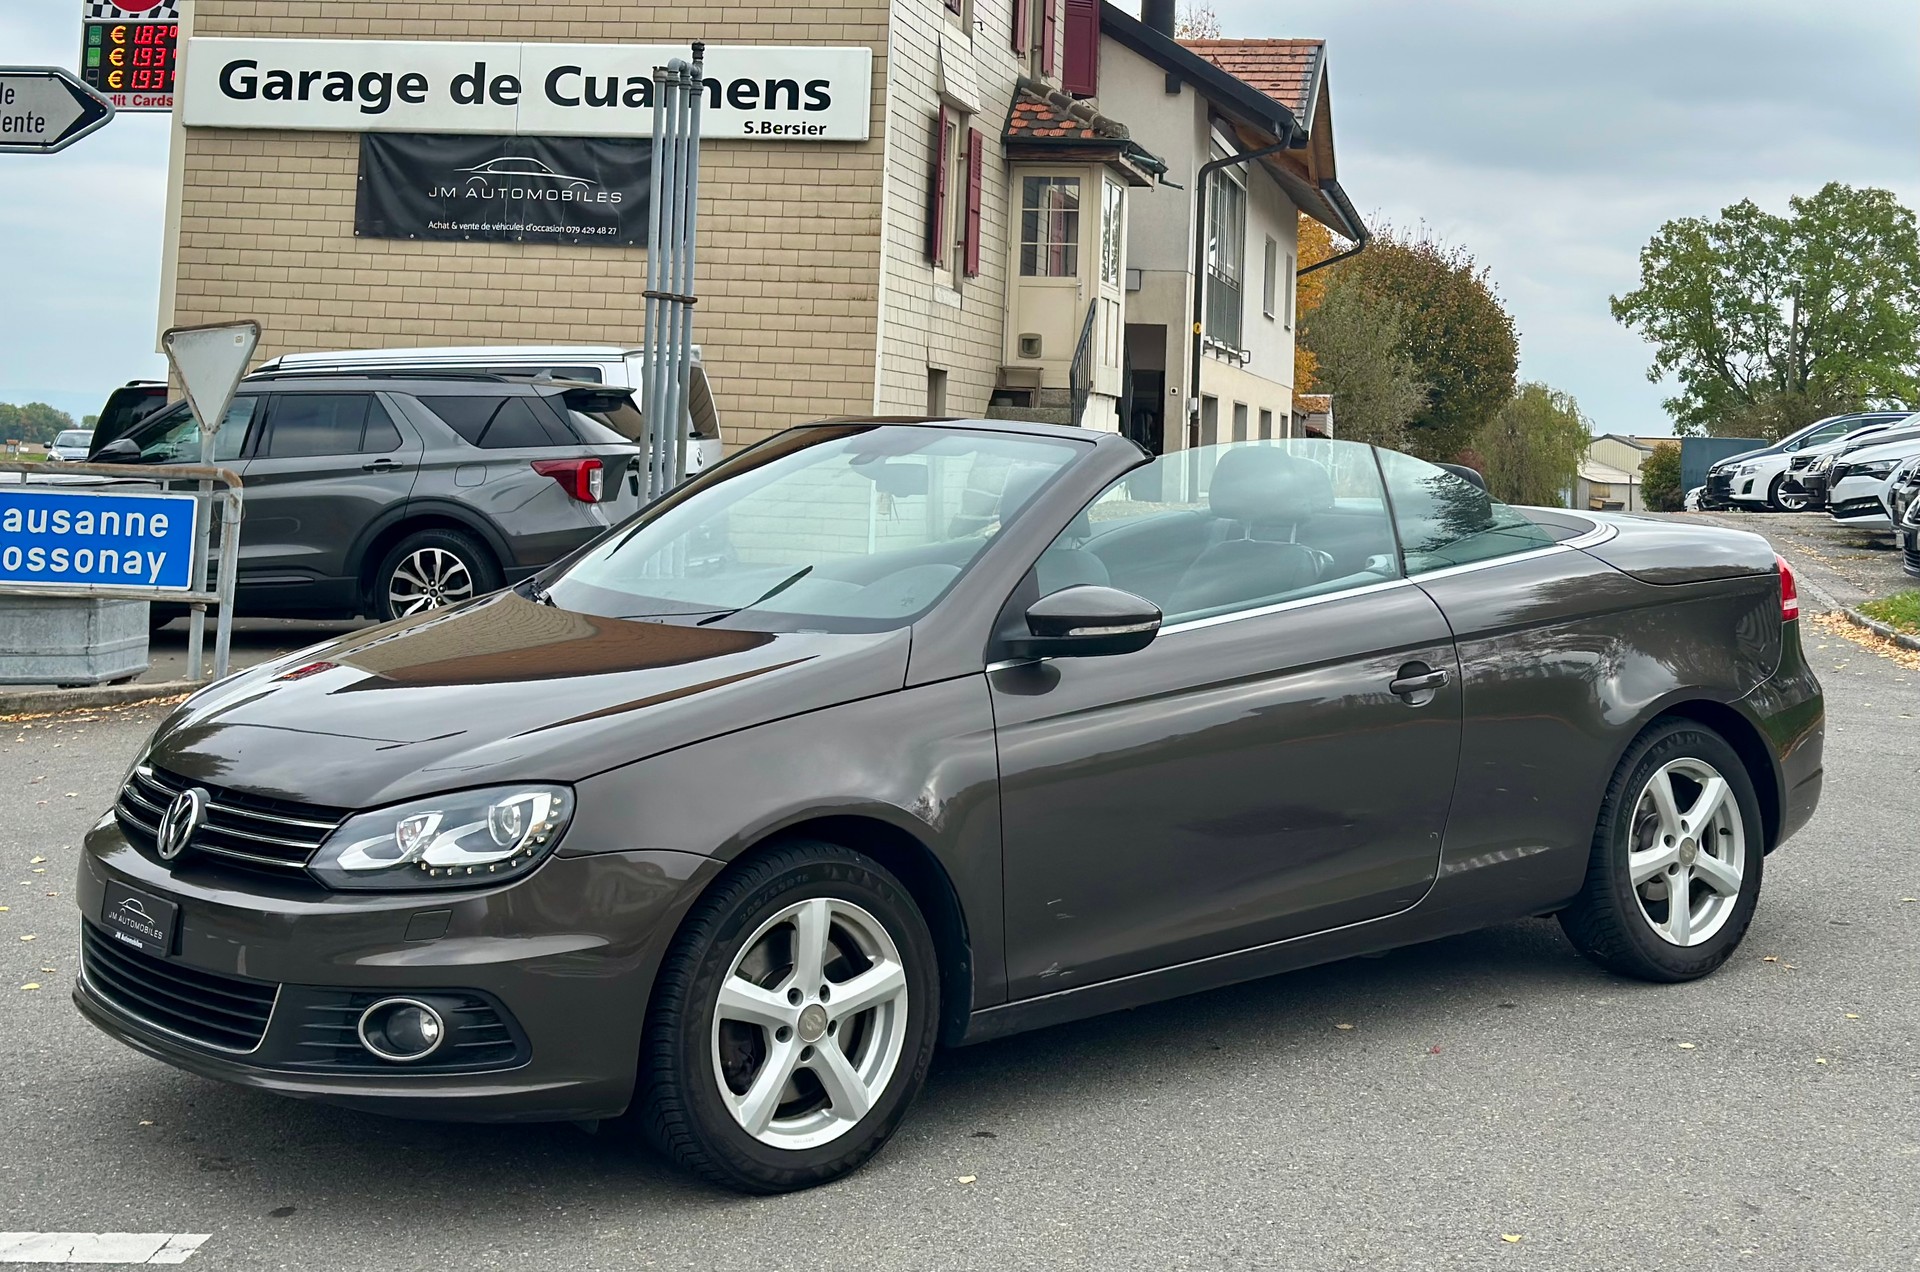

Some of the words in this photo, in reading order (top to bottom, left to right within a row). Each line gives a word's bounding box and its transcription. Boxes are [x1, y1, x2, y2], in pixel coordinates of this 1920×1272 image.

[110, 26, 127, 44] €
[109, 47, 126, 66] €
[108, 70, 124, 88] €
[218, 59, 429, 115] Garage
[449, 61, 522, 105] de
[544, 65, 832, 112] Cuanens
[133, 94, 174, 107] Cards
[0, 110, 45, 133] ente
[743, 121, 828, 136] S.Bersier
[428, 186, 456, 198] JM
[465, 187, 622, 204] AUTOMOBILES
[428, 220, 450, 230] Achat
[451, 221, 458, 230] &
[459, 222, 480, 231] vente
[481, 221, 491, 231] de
[491, 221, 524, 232] véhicules
[525, 221, 565, 233] d'occasion
[565, 225, 580, 234] 079
[581, 226, 595, 235] 429
[597, 226, 607, 235] 48
[608, 226, 617, 235] 27
[2, 508, 169, 538] ausanne
[1, 546, 167, 584] ossonay
[108, 911, 118, 921] JM
[118, 915, 163, 940] AUTOMOBILES
